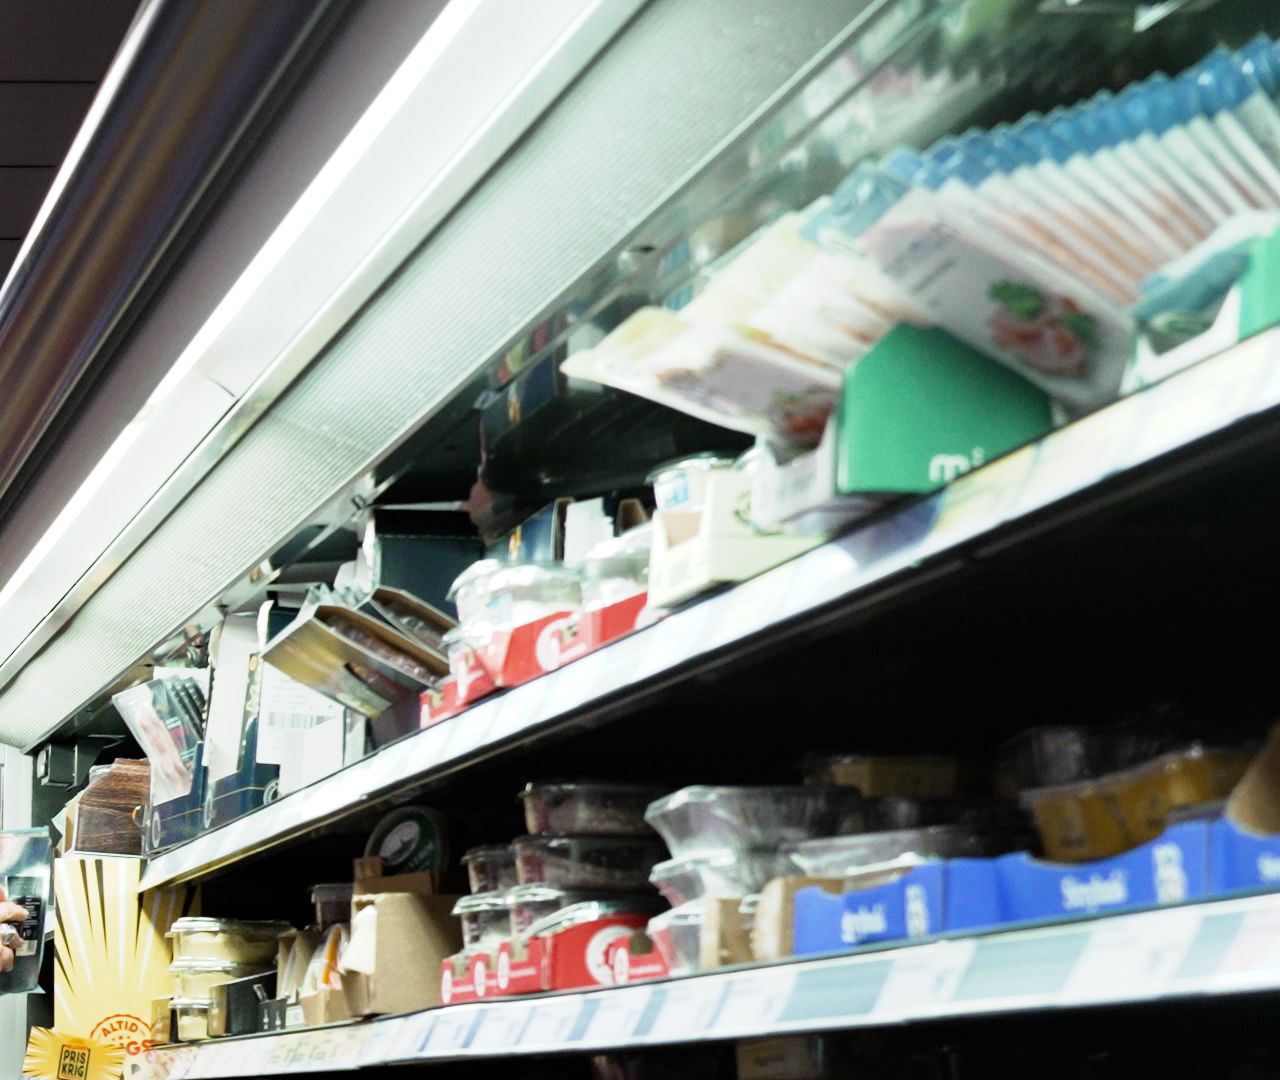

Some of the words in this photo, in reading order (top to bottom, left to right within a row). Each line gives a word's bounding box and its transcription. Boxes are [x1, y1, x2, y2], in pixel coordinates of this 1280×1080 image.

[101, 1020, 139, 1038] ALTID
[62, 1049, 87, 1064] PRIS
[61, 1063, 85, 1077] KRIG
